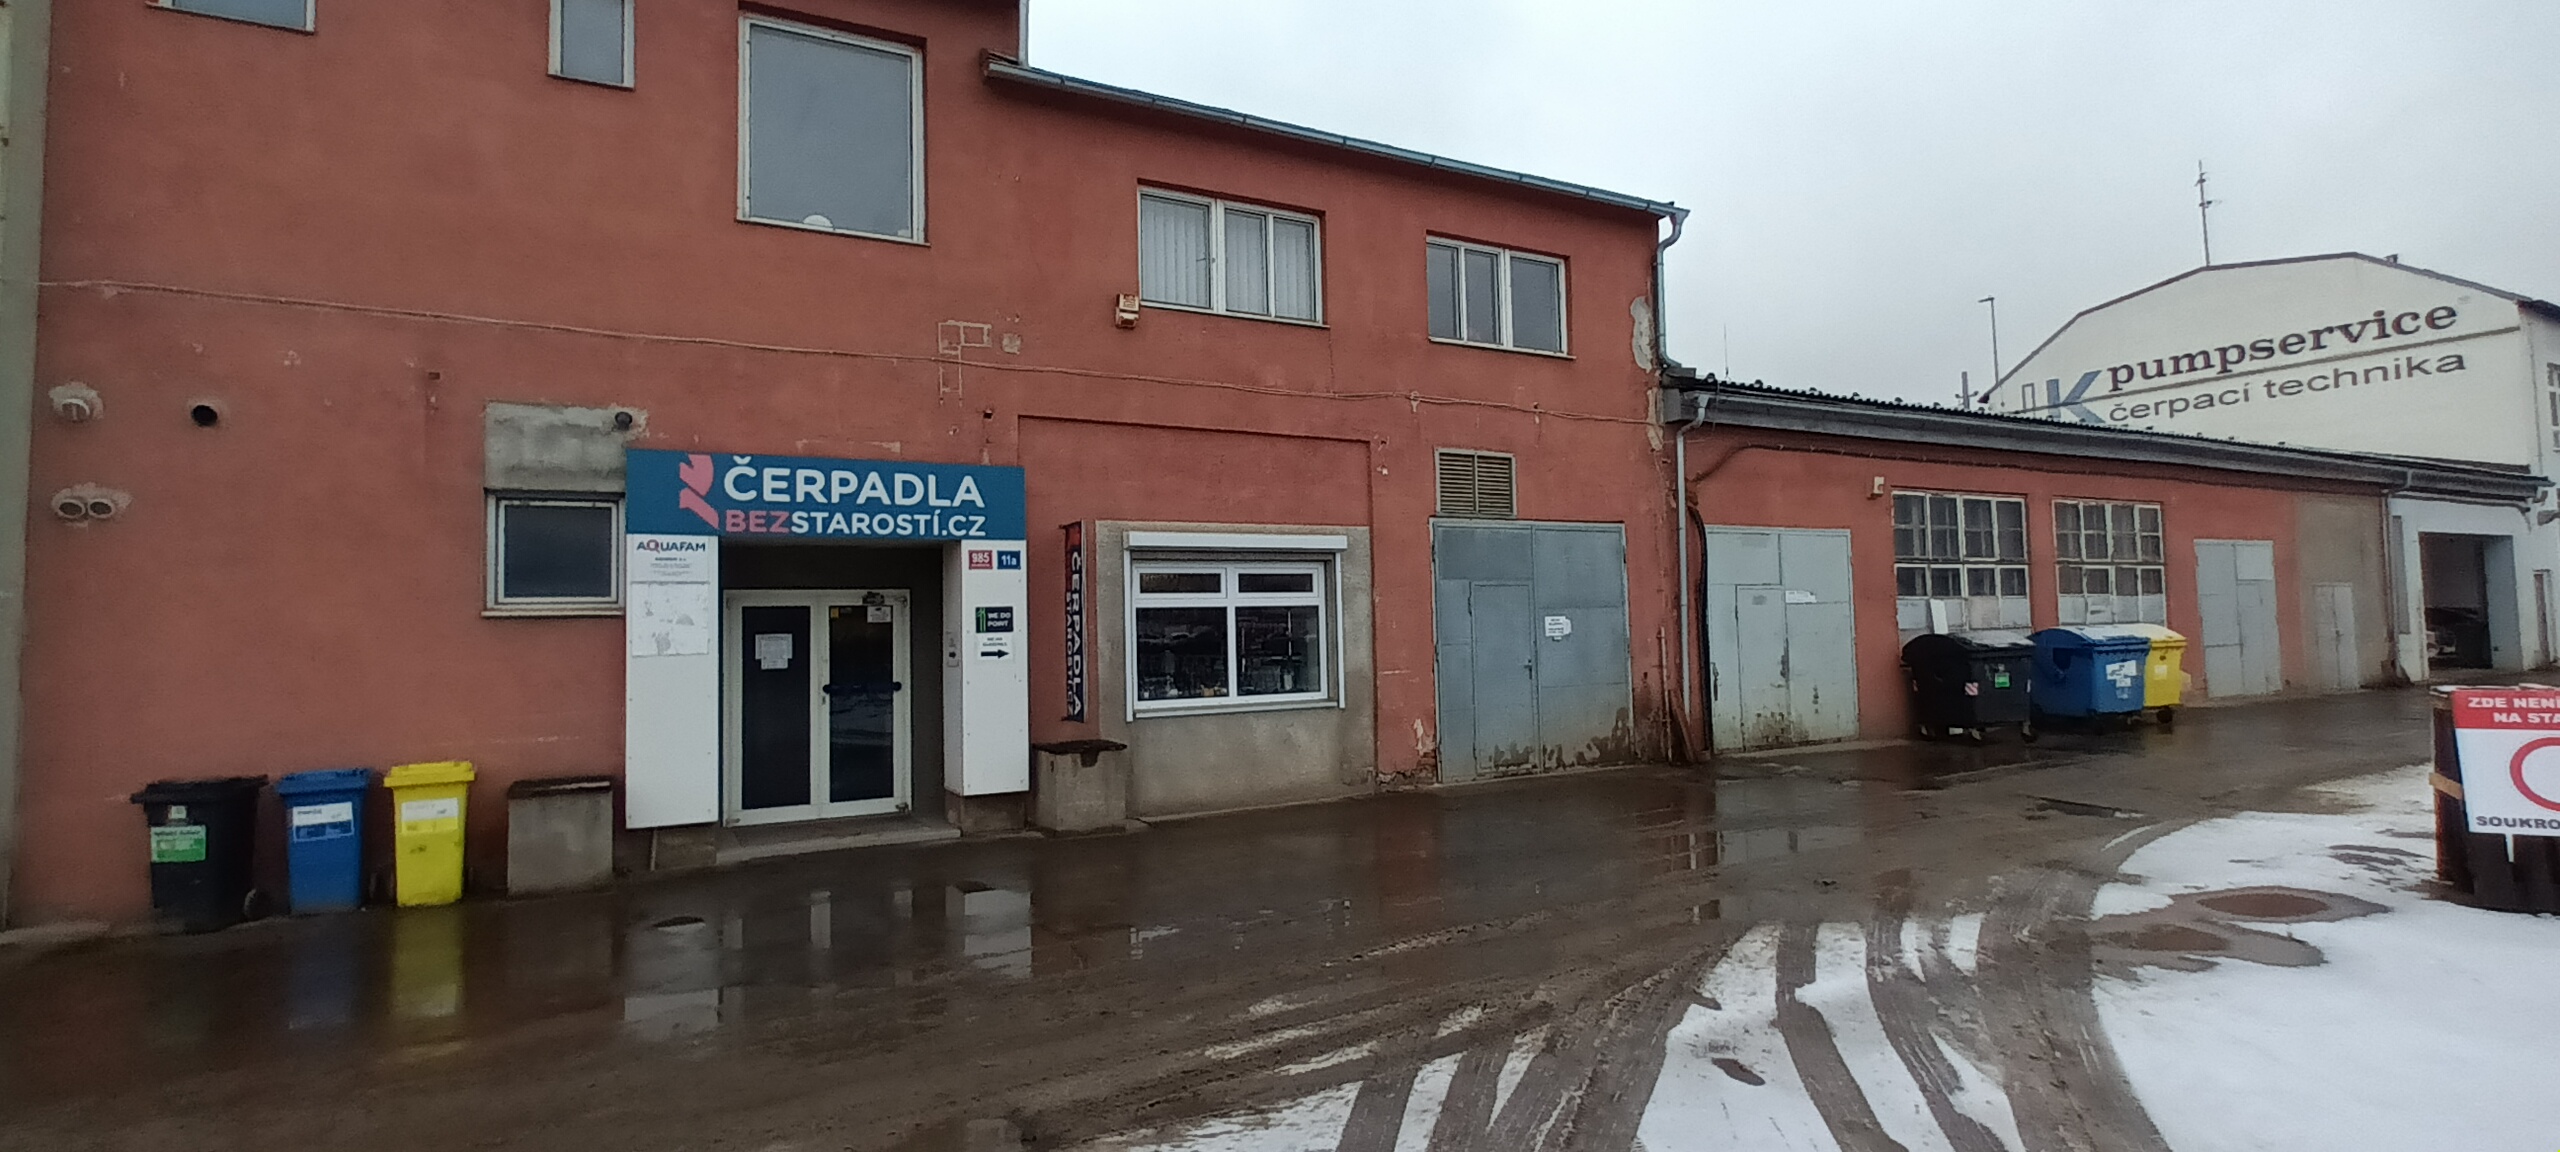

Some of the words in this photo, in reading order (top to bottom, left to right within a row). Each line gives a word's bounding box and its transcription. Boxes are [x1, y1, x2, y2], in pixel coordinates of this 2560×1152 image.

[2107, 304, 2457, 391] pumpservice
[2109, 383, 2250, 424] čerpací
[2262, 351, 2467, 399] technika
[723, 455, 985, 508] ČERPADLA
[725, 509, 986, 536] BEZSTAROSTÍ.CZ
[636, 539, 706, 554] AQUAFAM
[971, 552, 990, 563] 985
[1001, 554, 1017, 566] 11a
[1071, 551, 1082, 716] ČERPADLA
[2468, 697, 2508, 708] ZDE
[2493, 712, 2523, 723] NA
